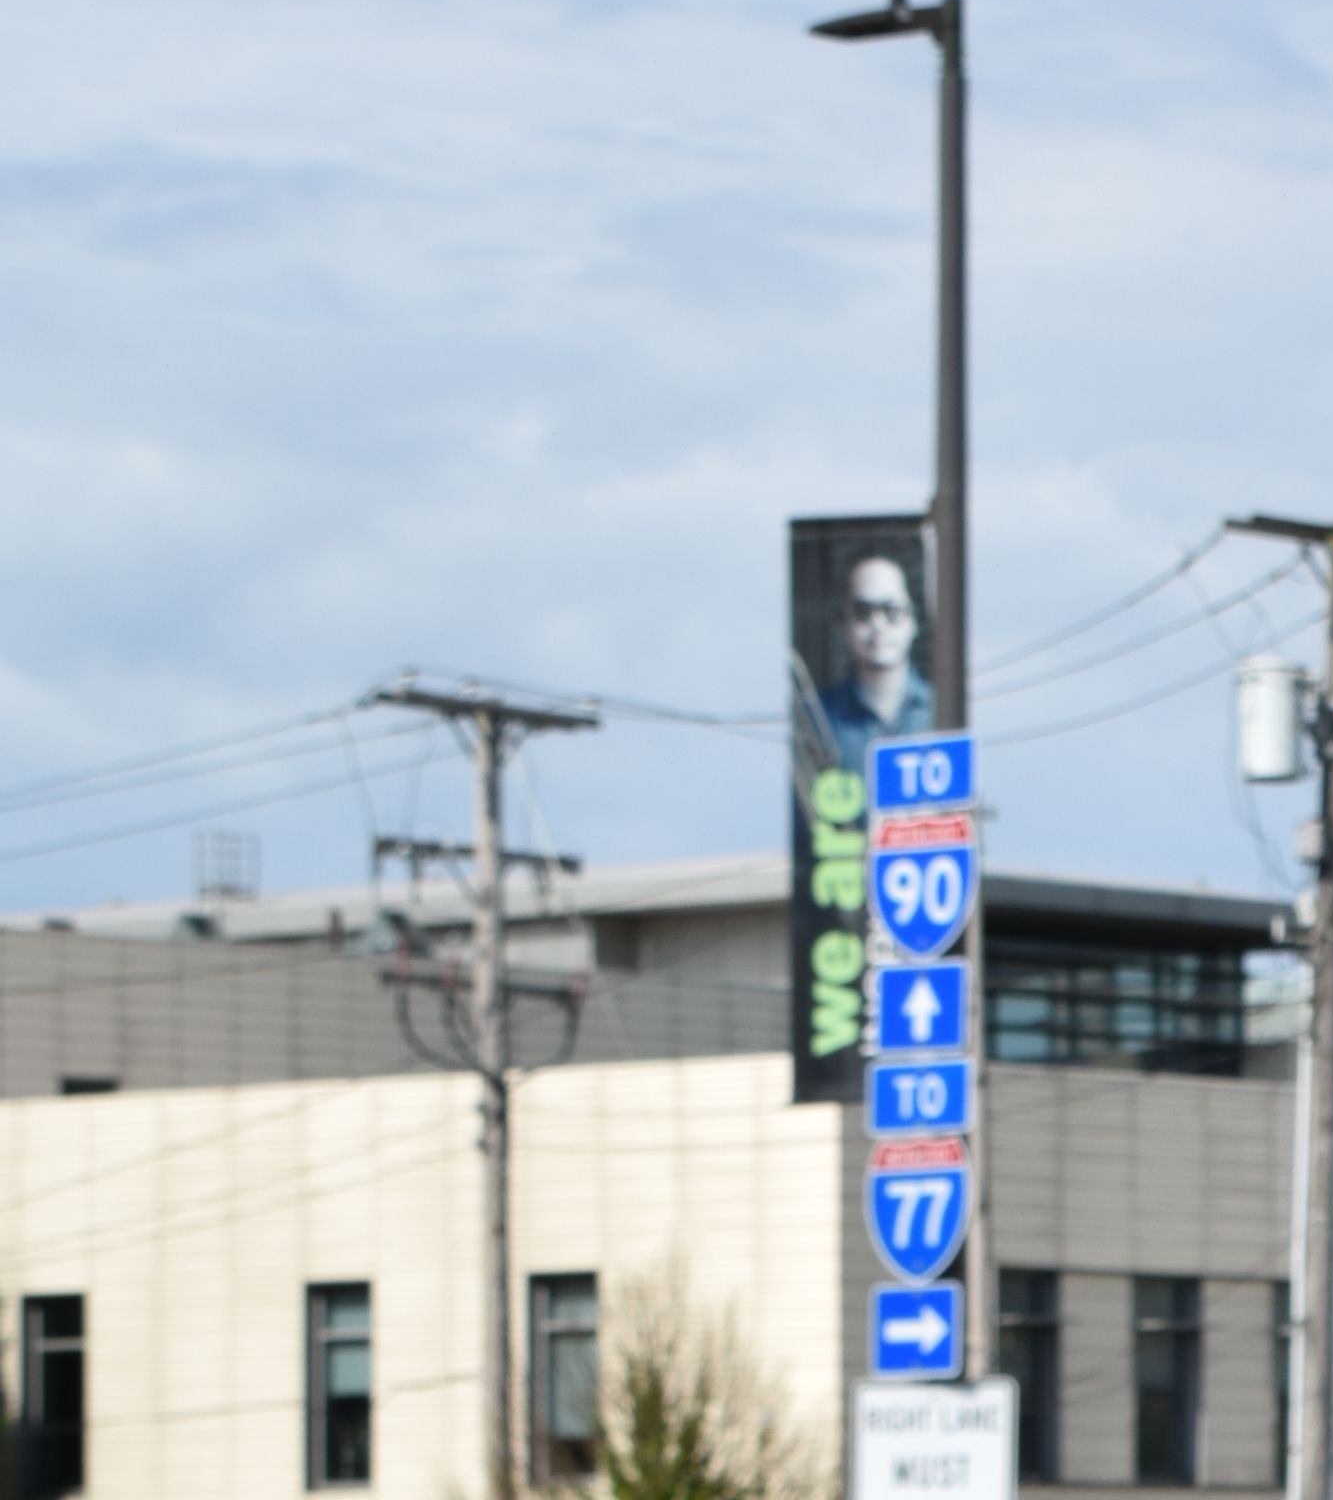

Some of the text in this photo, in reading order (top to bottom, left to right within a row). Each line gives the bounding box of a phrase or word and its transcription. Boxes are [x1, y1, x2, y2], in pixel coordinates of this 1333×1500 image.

[895, 751, 952, 798] TO
[811, 768, 865, 1057] we are
[882, 855, 963, 926] 90
[892, 1073, 948, 1120] TO
[884, 1178, 954, 1250] 77
[866, 1404, 999, 1433] RIGHT LANE
[892, 1453, 970, 1488] MUST
